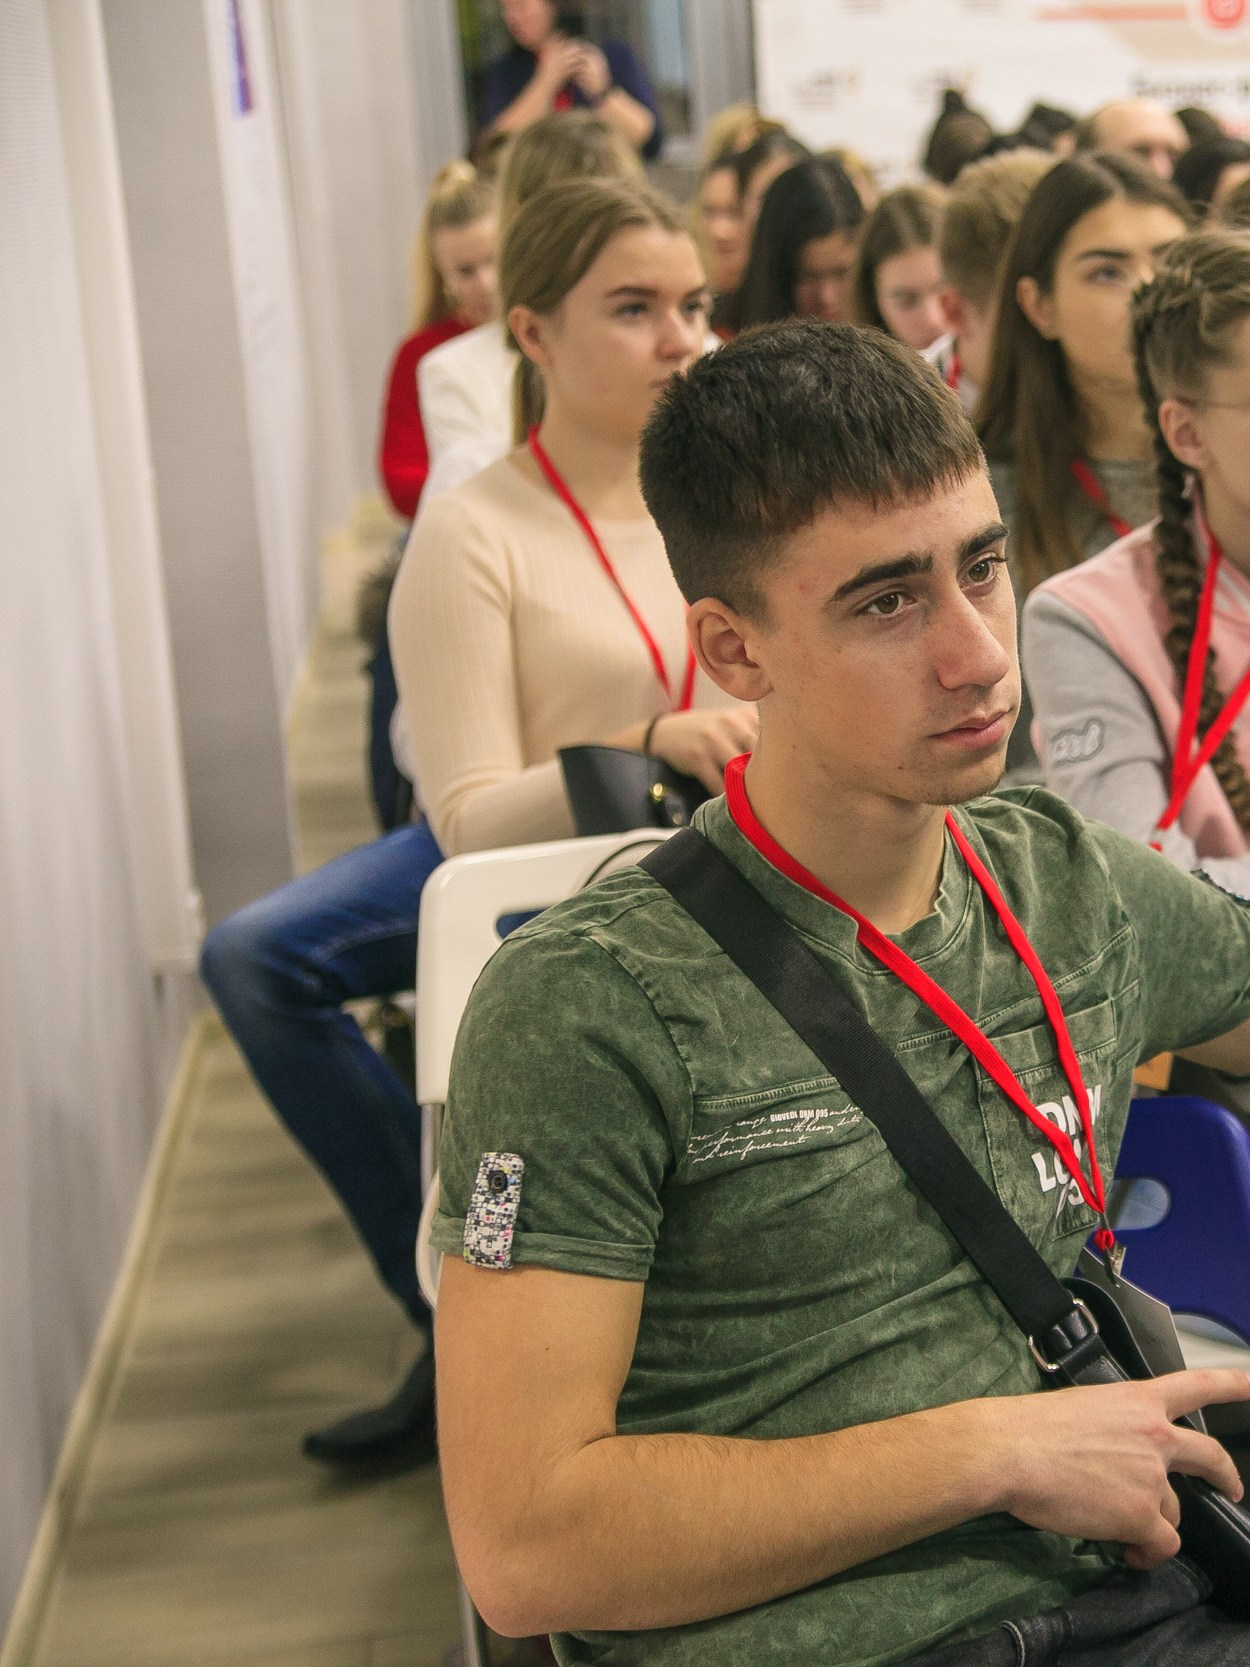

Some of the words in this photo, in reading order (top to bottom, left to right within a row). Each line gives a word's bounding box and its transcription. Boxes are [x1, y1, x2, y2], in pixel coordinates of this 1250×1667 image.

[770, 1110, 798, 1122] GIOVEDI
[776, 1116, 809, 1133] with
[805, 1117, 834, 1134] heavy
